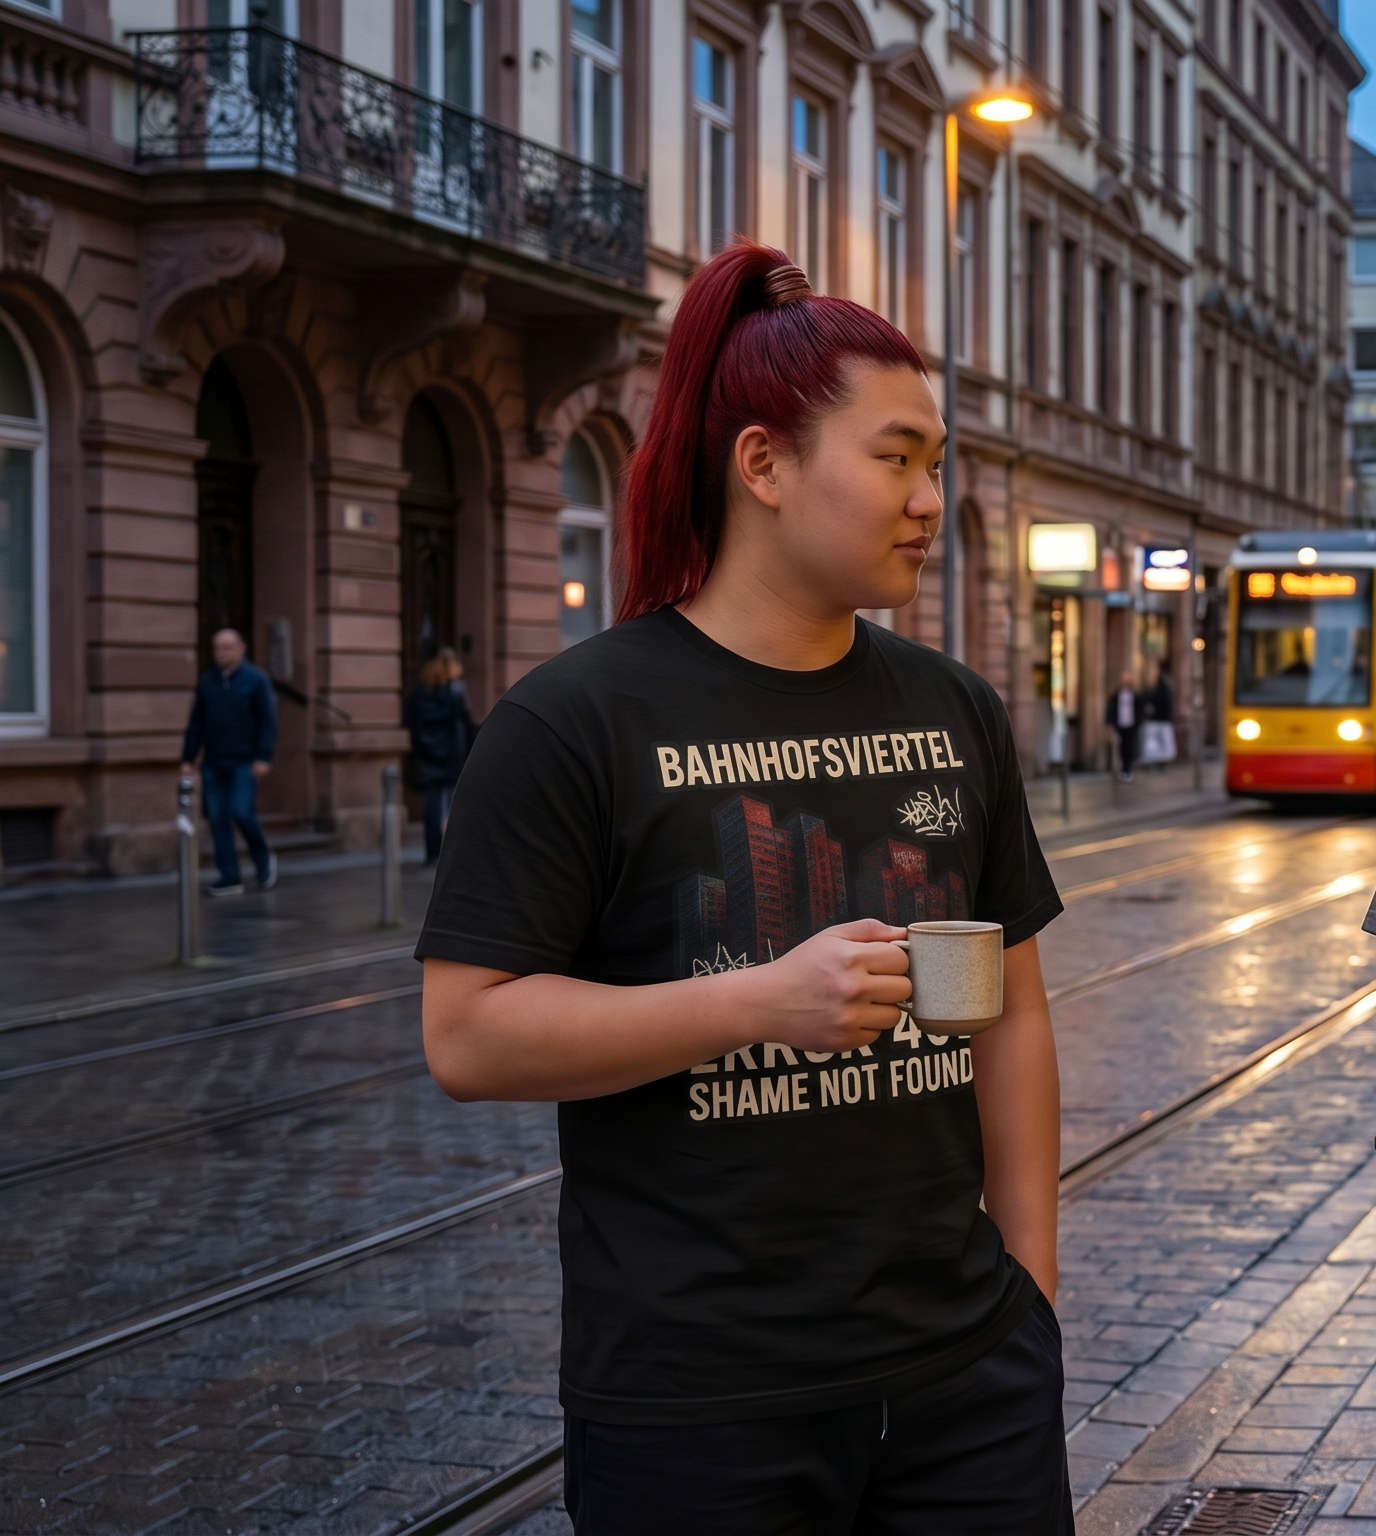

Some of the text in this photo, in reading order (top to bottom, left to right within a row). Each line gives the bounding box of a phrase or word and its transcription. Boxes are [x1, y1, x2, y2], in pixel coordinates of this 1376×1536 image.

[656, 730, 964, 788] BAHNHOFSVIERTEL
[689, 1072, 810, 1121] SHAME
[820, 1063, 879, 1108] NOT
[889, 1047, 974, 1098] FOUND
